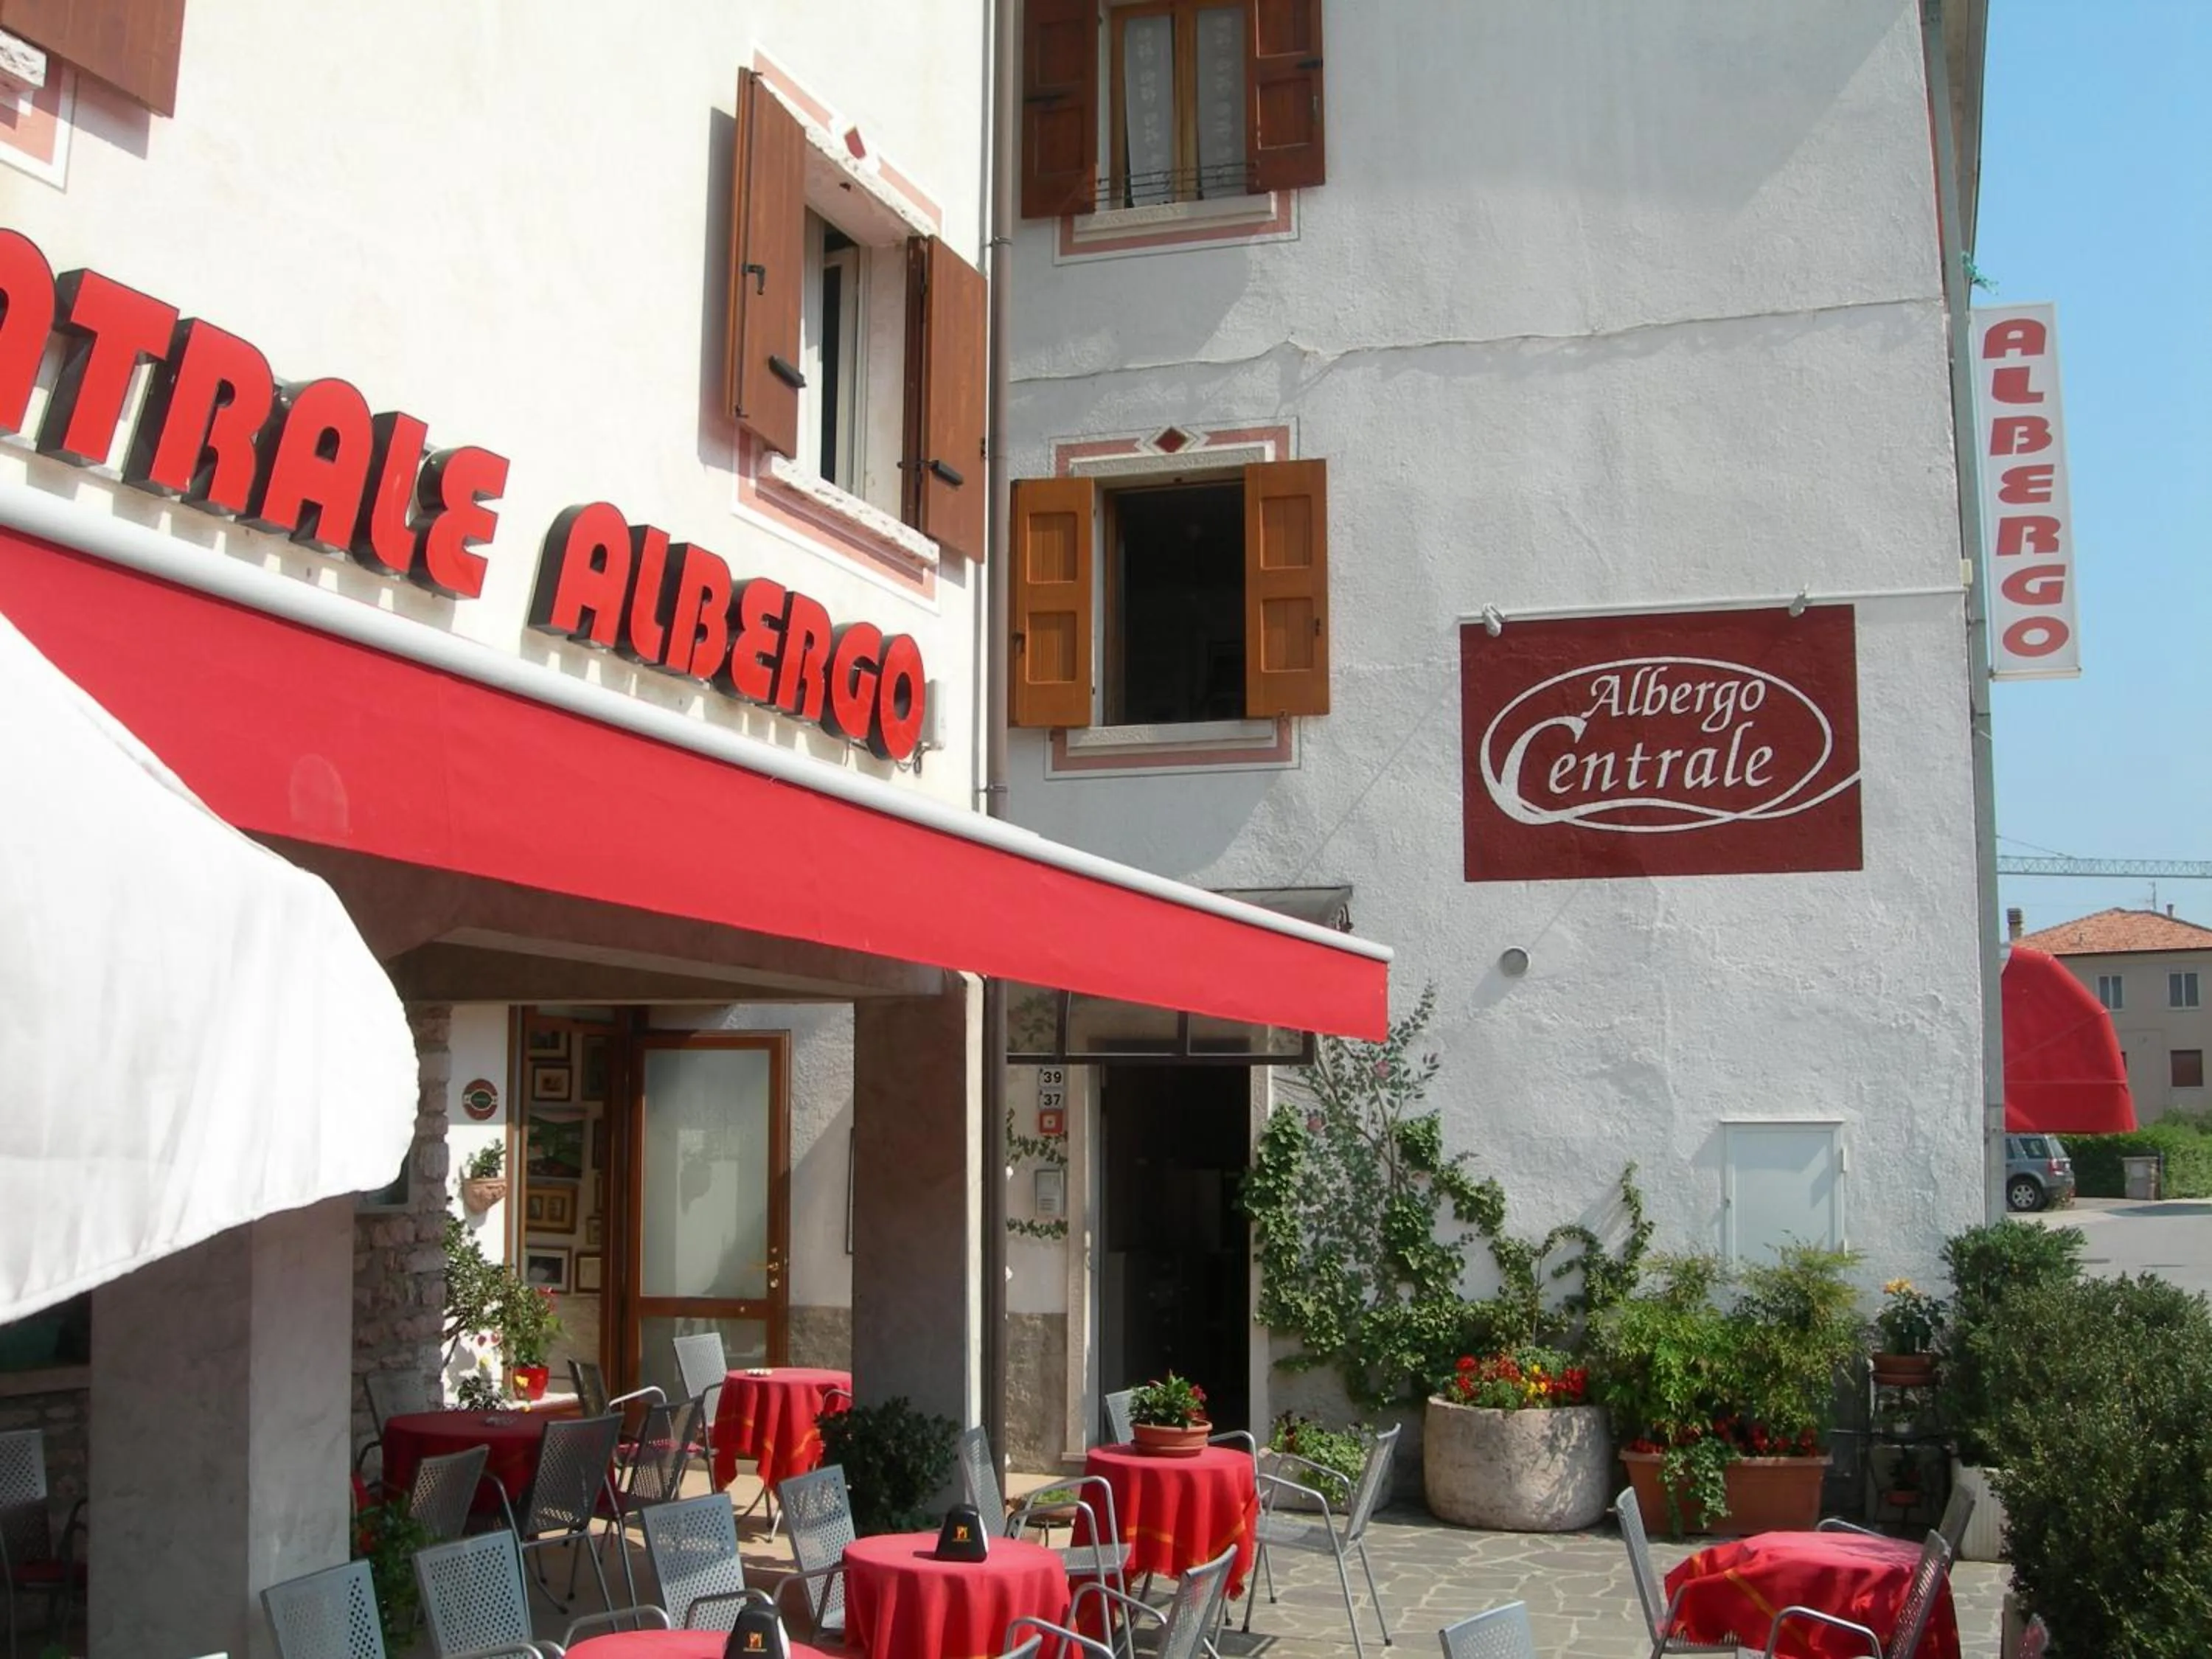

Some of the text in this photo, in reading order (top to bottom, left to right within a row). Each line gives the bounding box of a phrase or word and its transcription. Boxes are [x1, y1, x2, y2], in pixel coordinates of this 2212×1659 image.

[1982, 318, 2070, 658] ALBERGO
[547, 501, 925, 761] ALBERGO
[1583, 666, 1766, 732] Albergo
[1500, 715, 1774, 820] Centrale
[1043, 1071, 1062, 1083] 39
[1043, 1093, 1061, 1105] 37
